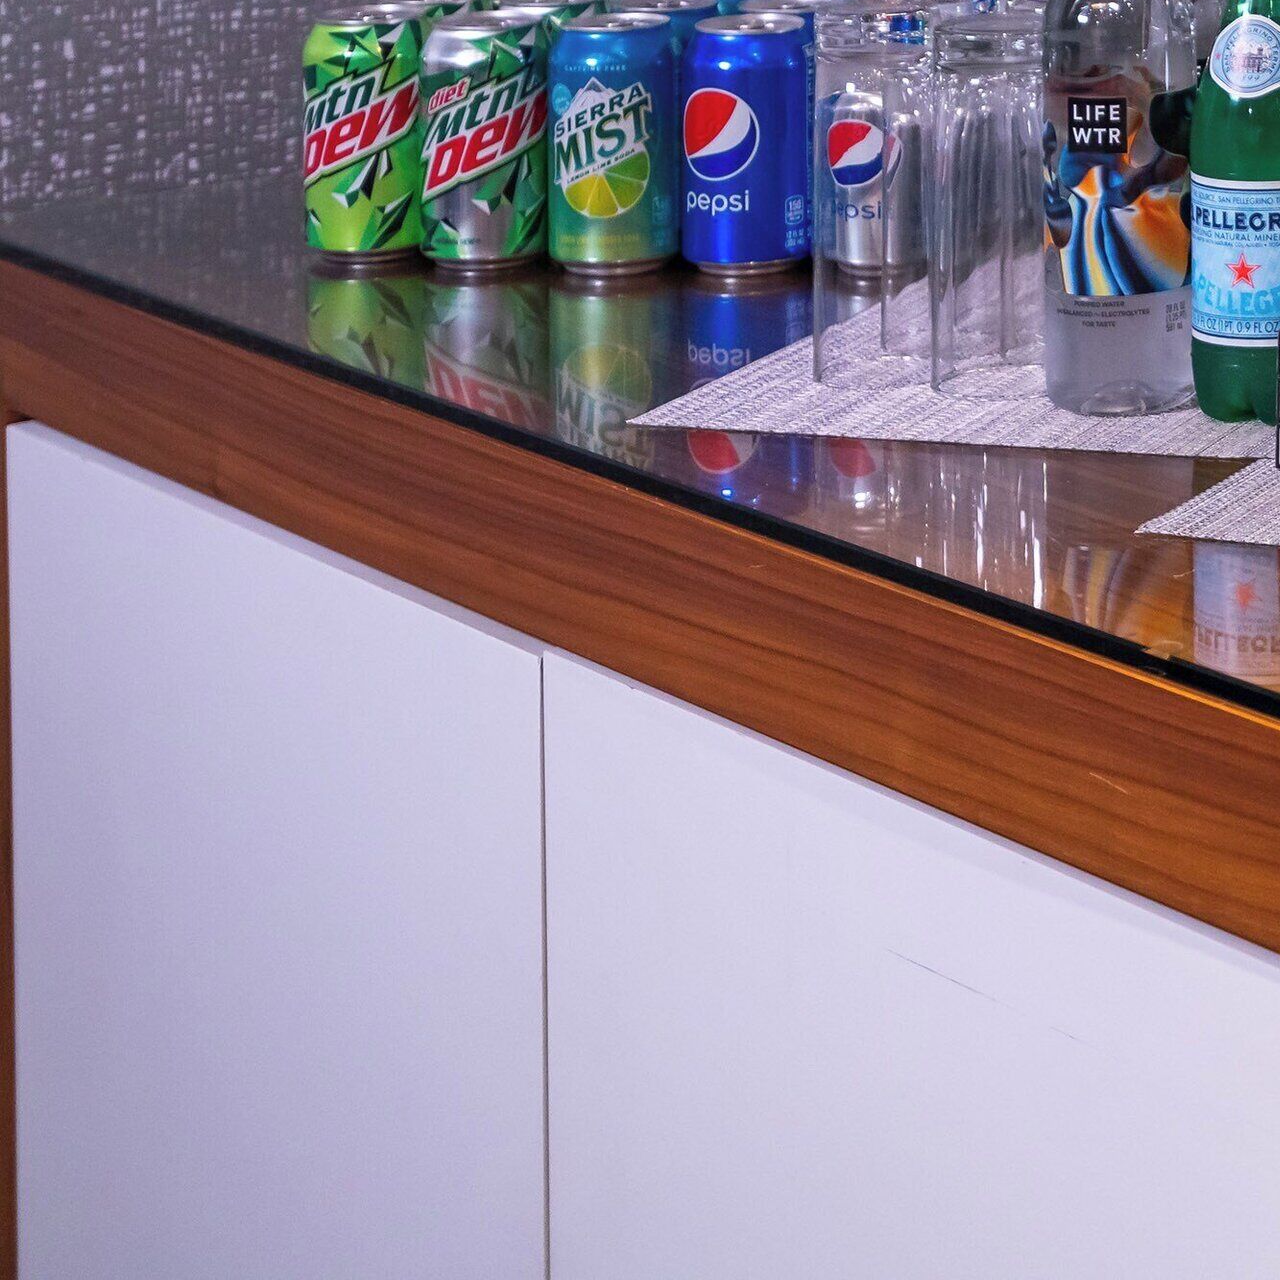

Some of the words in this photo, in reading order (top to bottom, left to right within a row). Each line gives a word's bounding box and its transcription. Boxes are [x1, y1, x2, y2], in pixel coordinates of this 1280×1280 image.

[429, 78, 467, 111] diet
[556, 85, 644, 138] SIERRA
[1072, 104, 1121, 121] LIFE
[554, 94, 651, 181] MIST
[1072, 127, 1121, 144] WTR
[614, 148, 636, 161] SODA
[687, 189, 750, 216] pepsi
[1232, 196, 1274, 205] PELLEGRINO
[1214, 231, 1251, 242] NATURAL
[1253, 322, 1263, 333] FL
